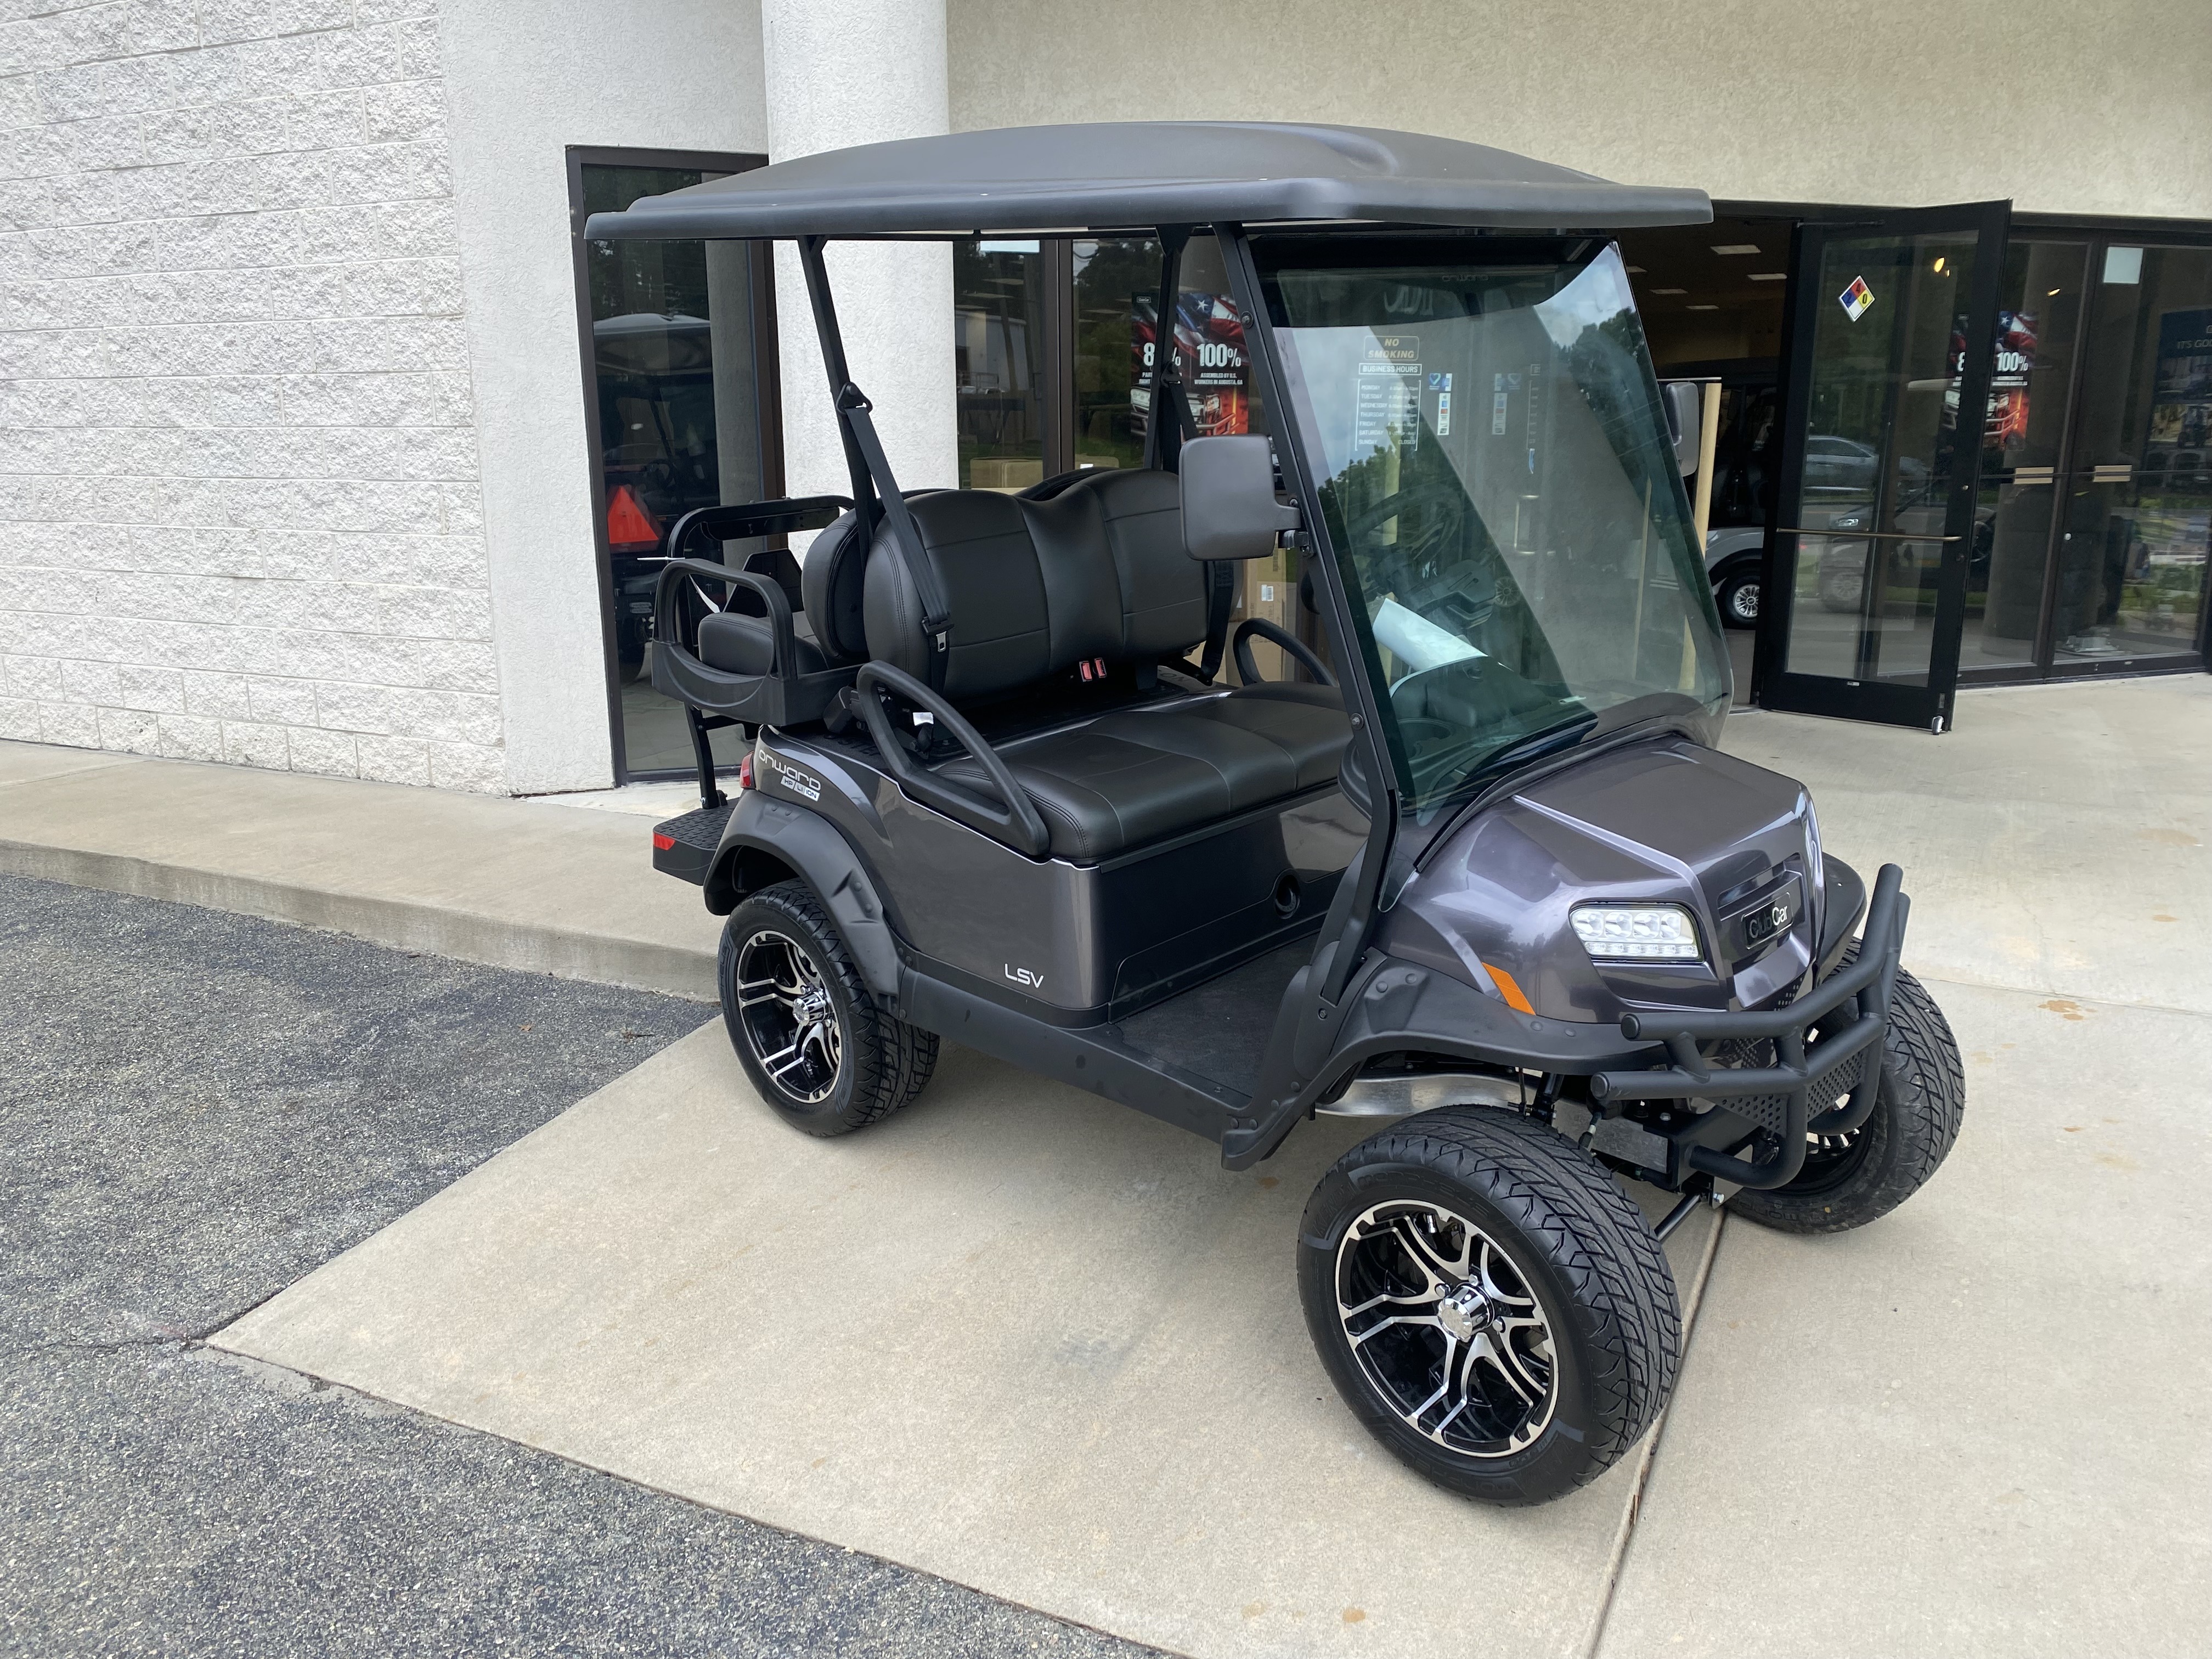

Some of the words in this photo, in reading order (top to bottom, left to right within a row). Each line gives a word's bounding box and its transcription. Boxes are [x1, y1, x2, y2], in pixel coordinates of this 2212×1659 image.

[1863, 294, 1867, 304] 0
[1197, 343, 1241, 367] 100%
[1368, 350, 1414, 358] SMOKING
[1997, 352, 2028, 371] 100%
[805, 789, 817, 799] ION
[1005, 963, 1044, 988] LSV
